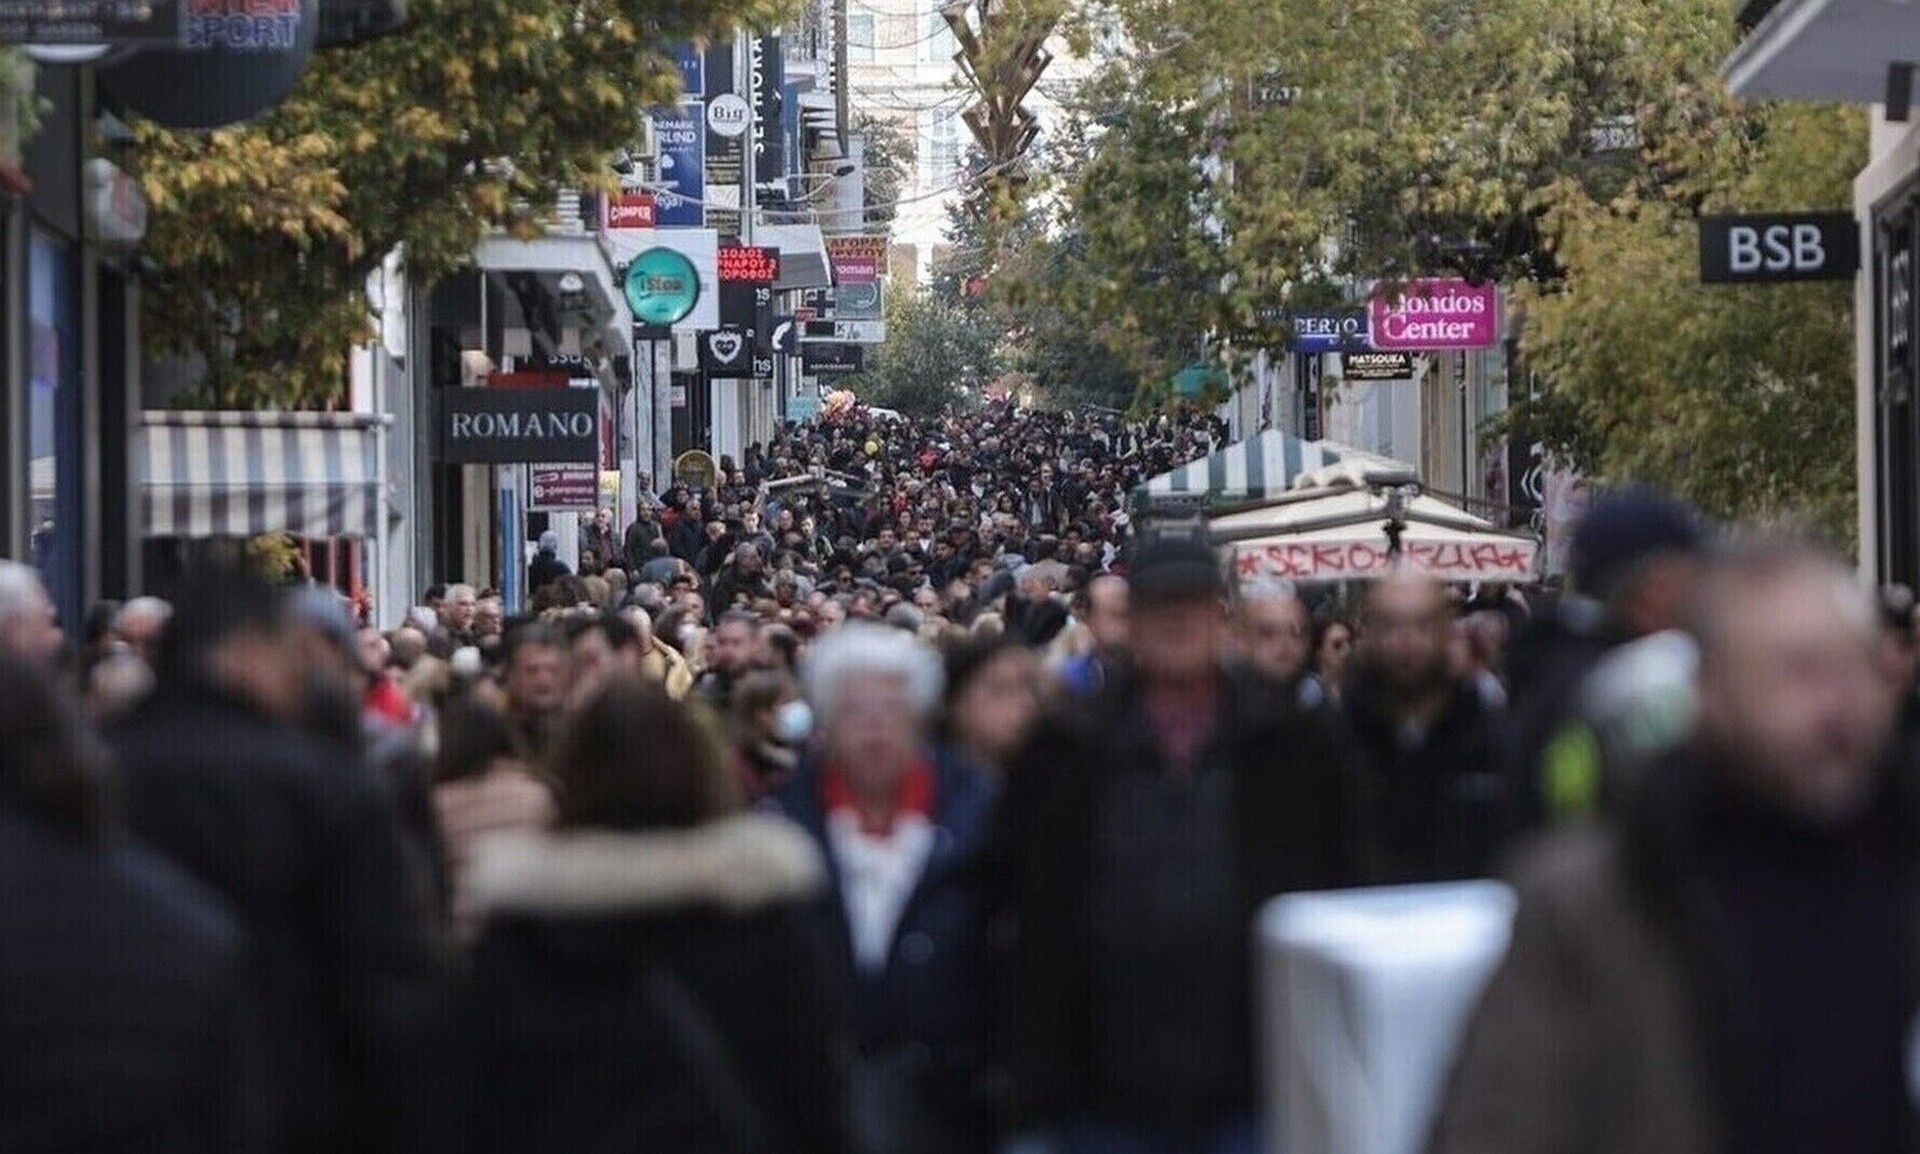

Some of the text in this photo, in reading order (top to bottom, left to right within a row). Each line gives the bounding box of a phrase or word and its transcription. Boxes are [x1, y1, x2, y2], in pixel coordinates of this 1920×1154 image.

[658, 131, 696, 143] RLIND
[1728, 224, 1825, 271] BSB
[834, 264, 875, 275] oman
[1383, 314, 1475, 340] Center
[1349, 354, 1406, 364] MATSOUKA
[452, 412, 593, 438] ROMANO
